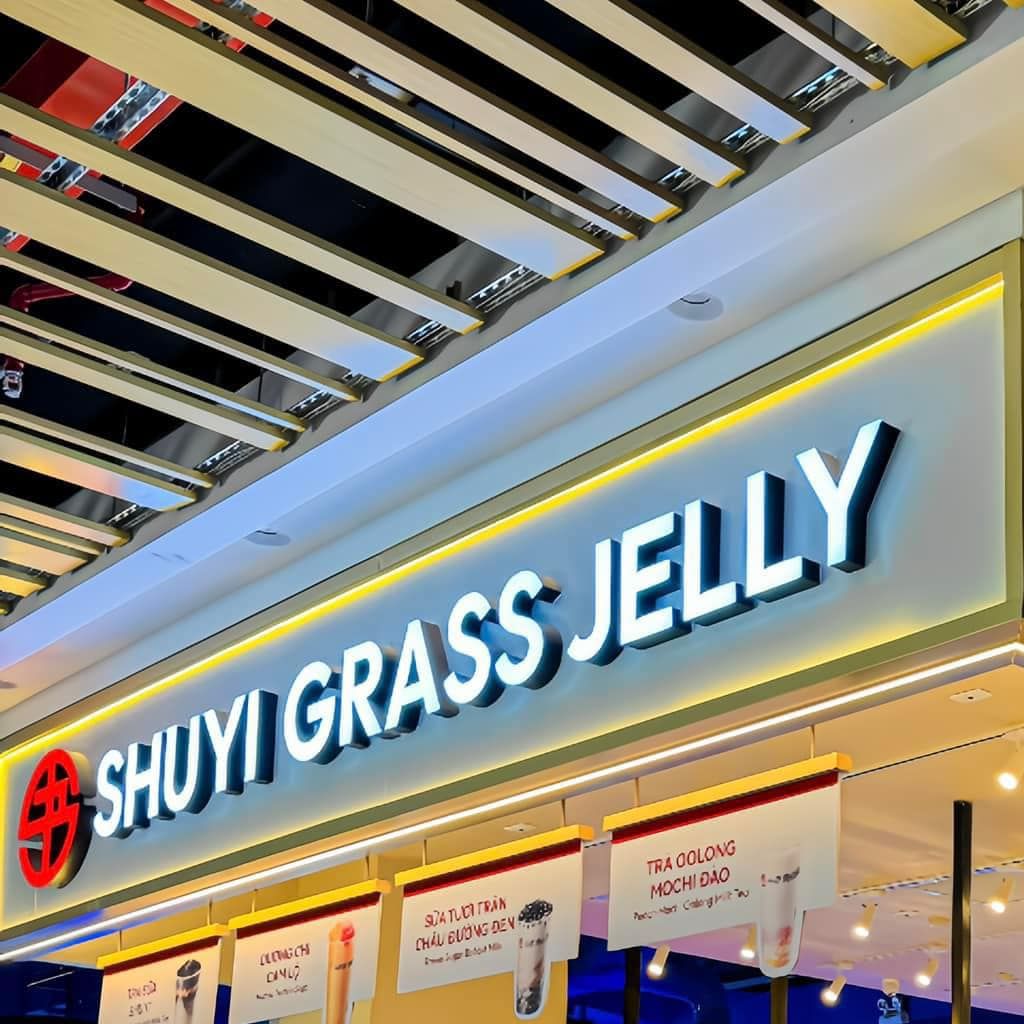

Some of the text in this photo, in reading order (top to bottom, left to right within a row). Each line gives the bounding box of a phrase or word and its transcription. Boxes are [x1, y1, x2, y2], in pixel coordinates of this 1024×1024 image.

[94, 419, 893, 838] SHUYI GRASS JELLY
[650, 873, 697, 900] MOCHI
